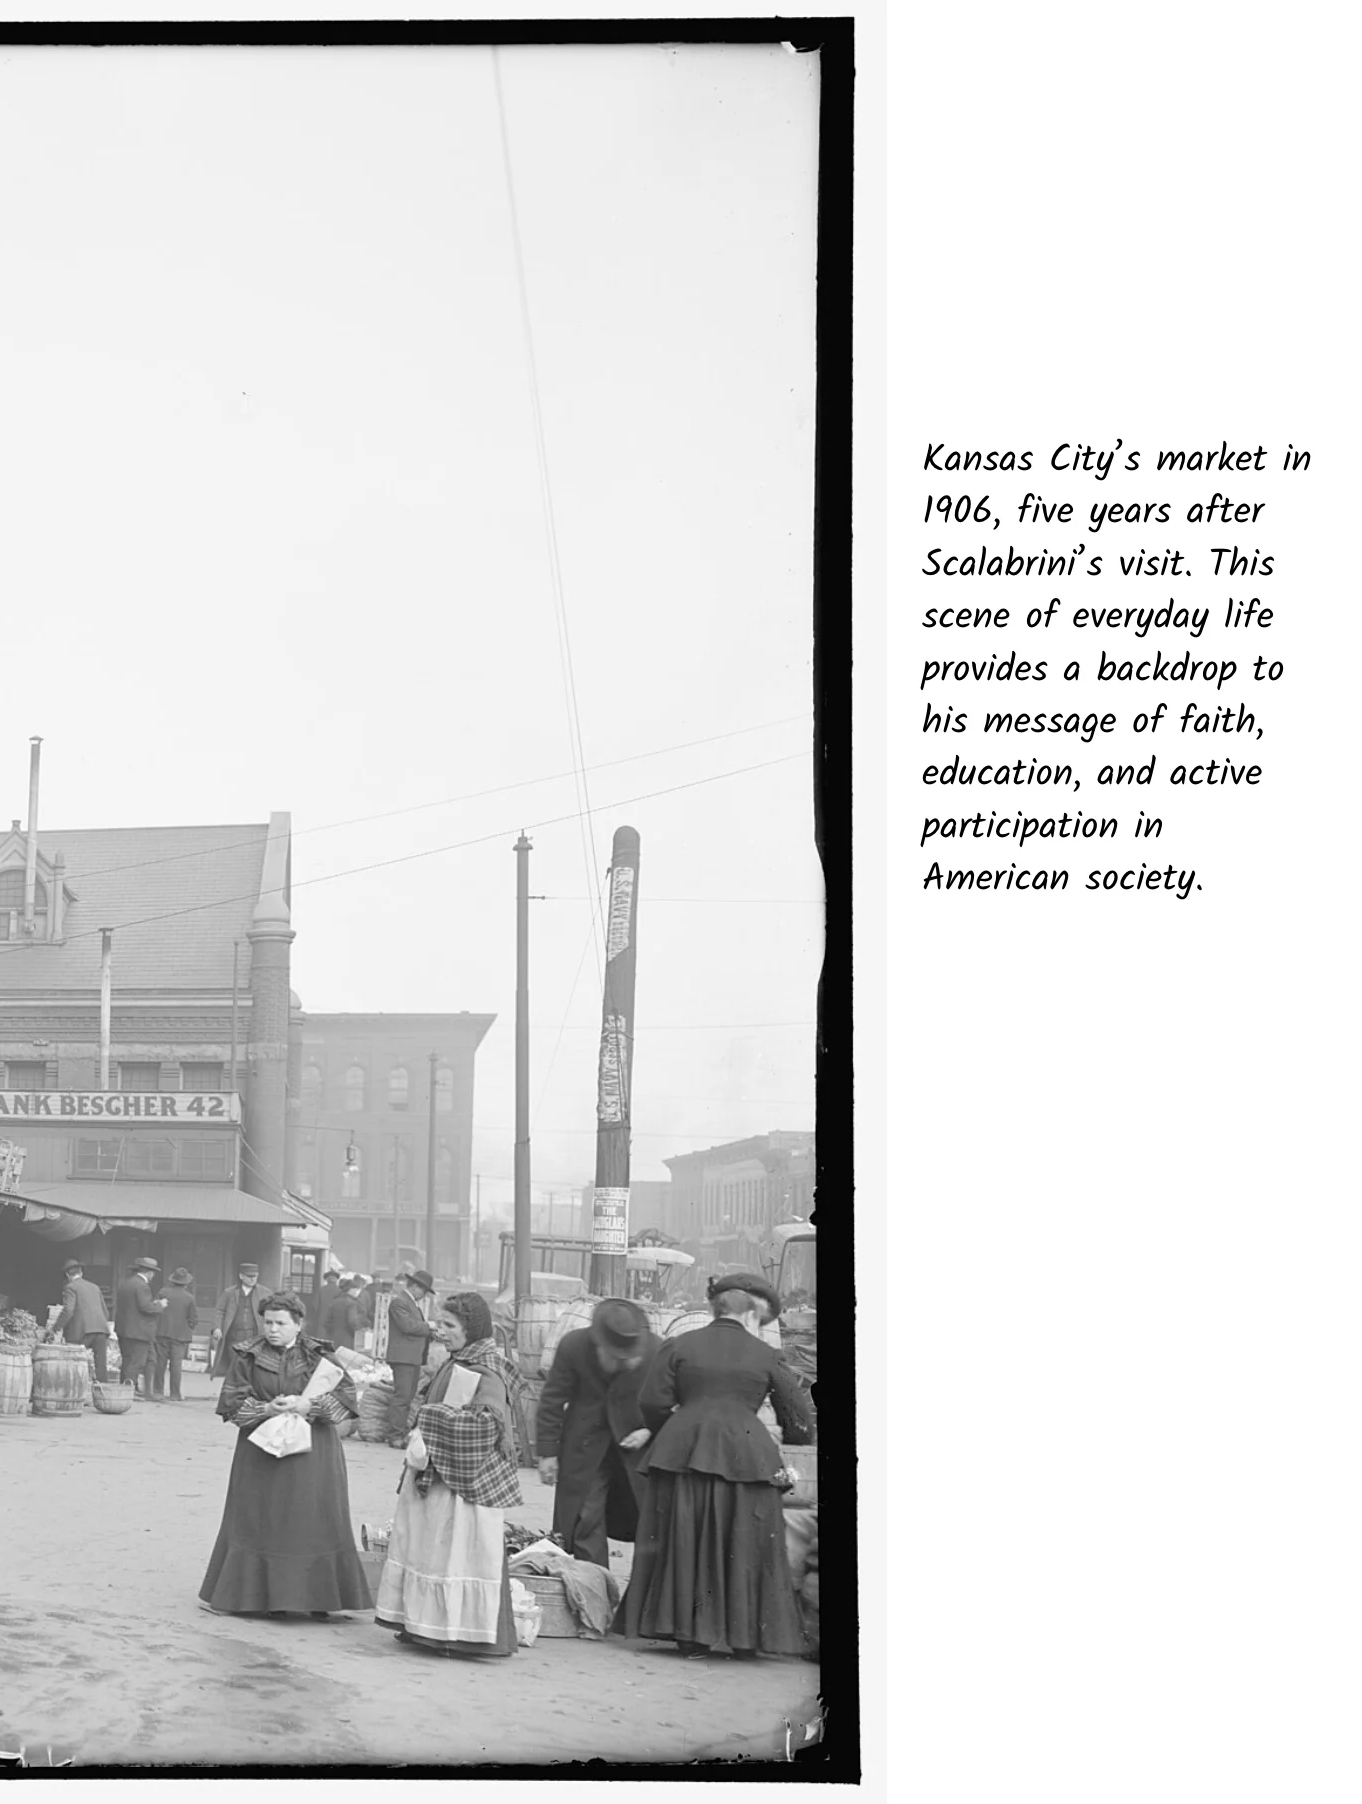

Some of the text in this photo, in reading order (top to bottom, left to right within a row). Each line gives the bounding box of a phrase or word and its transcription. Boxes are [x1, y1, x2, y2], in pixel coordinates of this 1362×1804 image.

[60, 1095, 179, 1116] BESCHER
[187, 1096, 225, 1116] 42
[602, 1206, 616, 1216] THE
